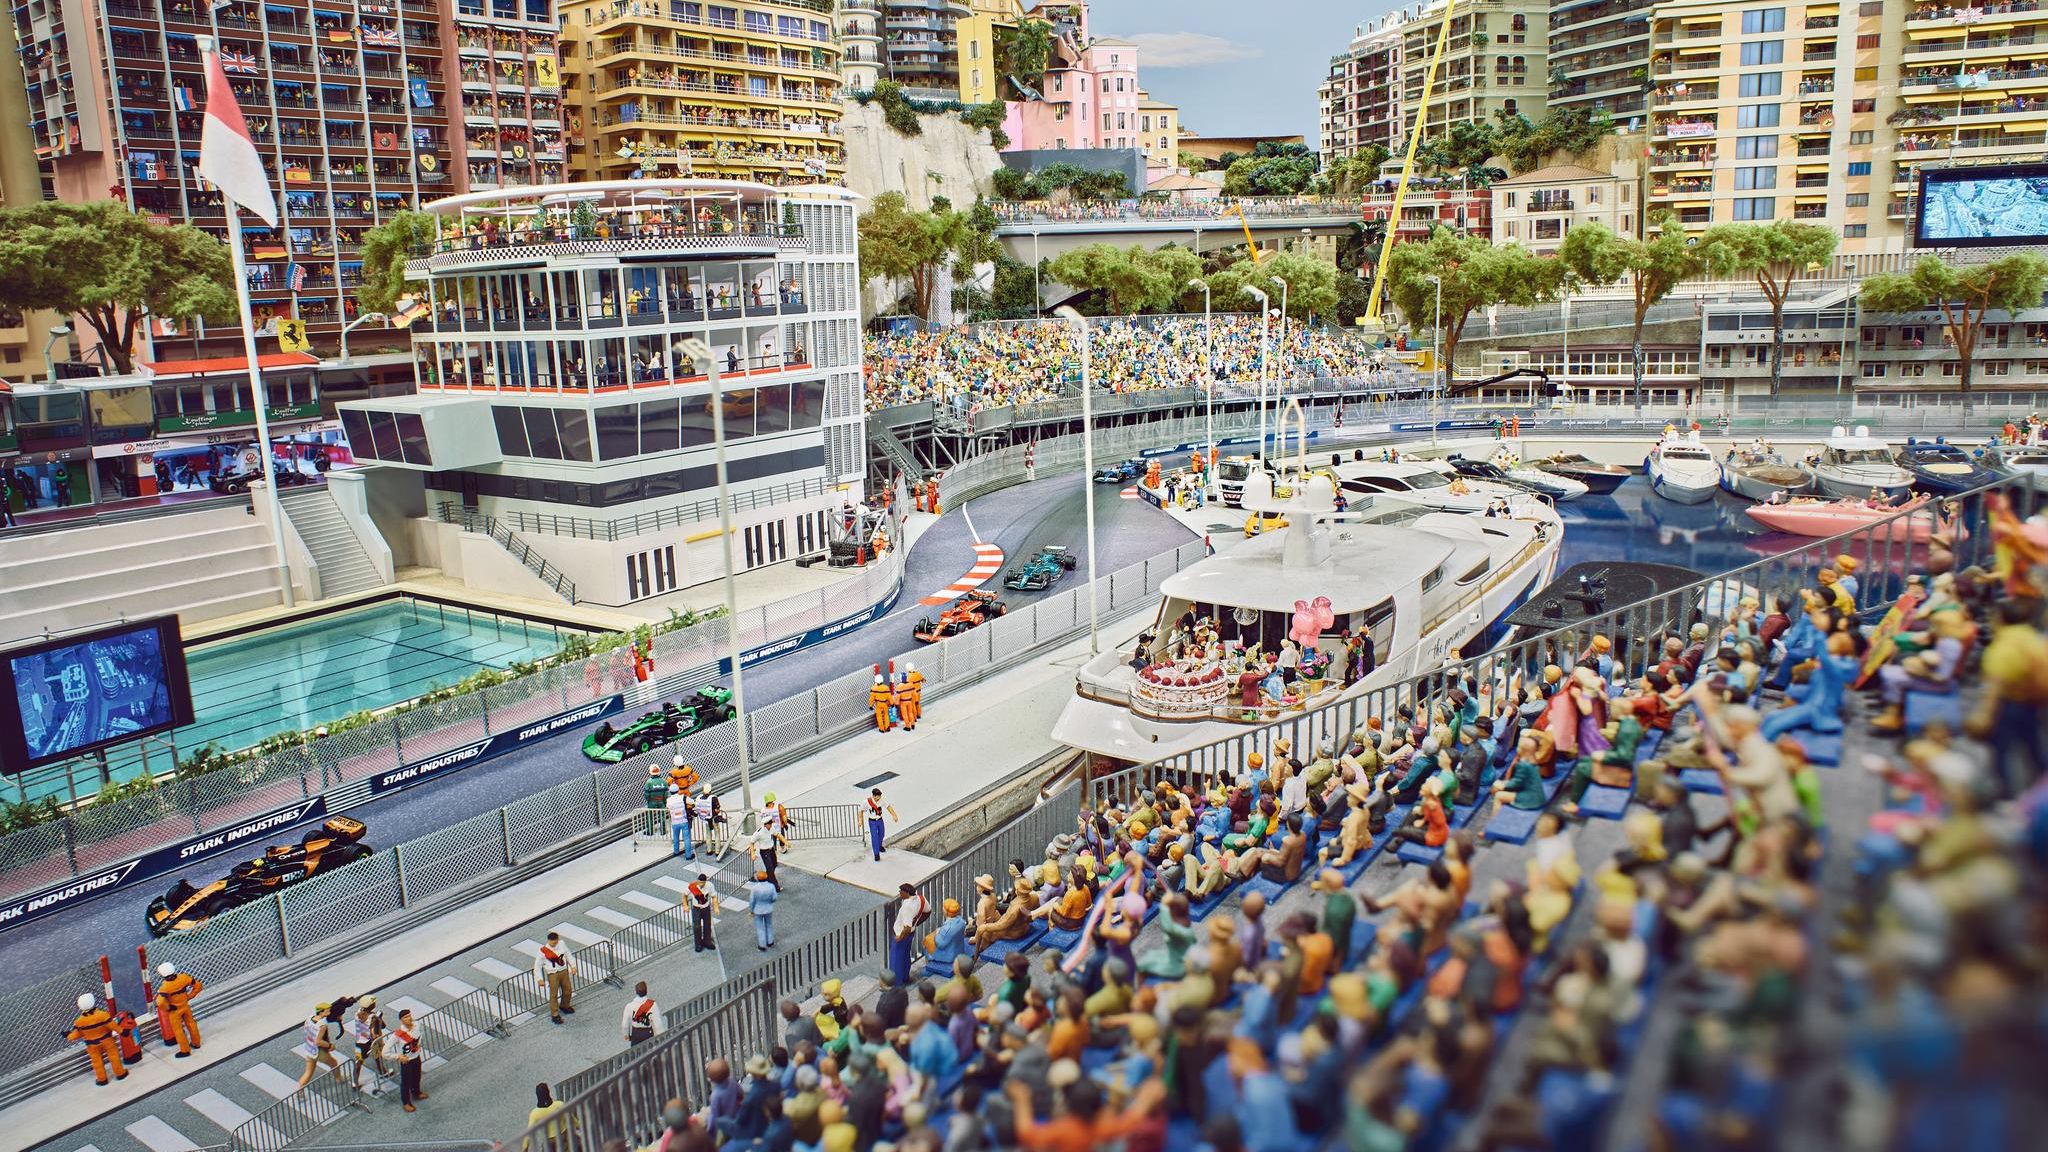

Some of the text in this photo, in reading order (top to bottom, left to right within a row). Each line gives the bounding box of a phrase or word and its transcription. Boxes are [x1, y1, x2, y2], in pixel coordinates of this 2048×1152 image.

[1738, 332, 1819, 340] MIRMAR
[207, 434, 221, 444] 20
[300, 424, 313, 433] 27
[739, 652, 759, 663] TARK
[518, 705, 601, 741] STARK INDUSTRIES
[382, 746, 479, 786] STARK INDUSTRIES
[180, 809, 300, 858] STARK INDUSTRIES
[0, 872, 119, 921] RK INDUSTRIES
